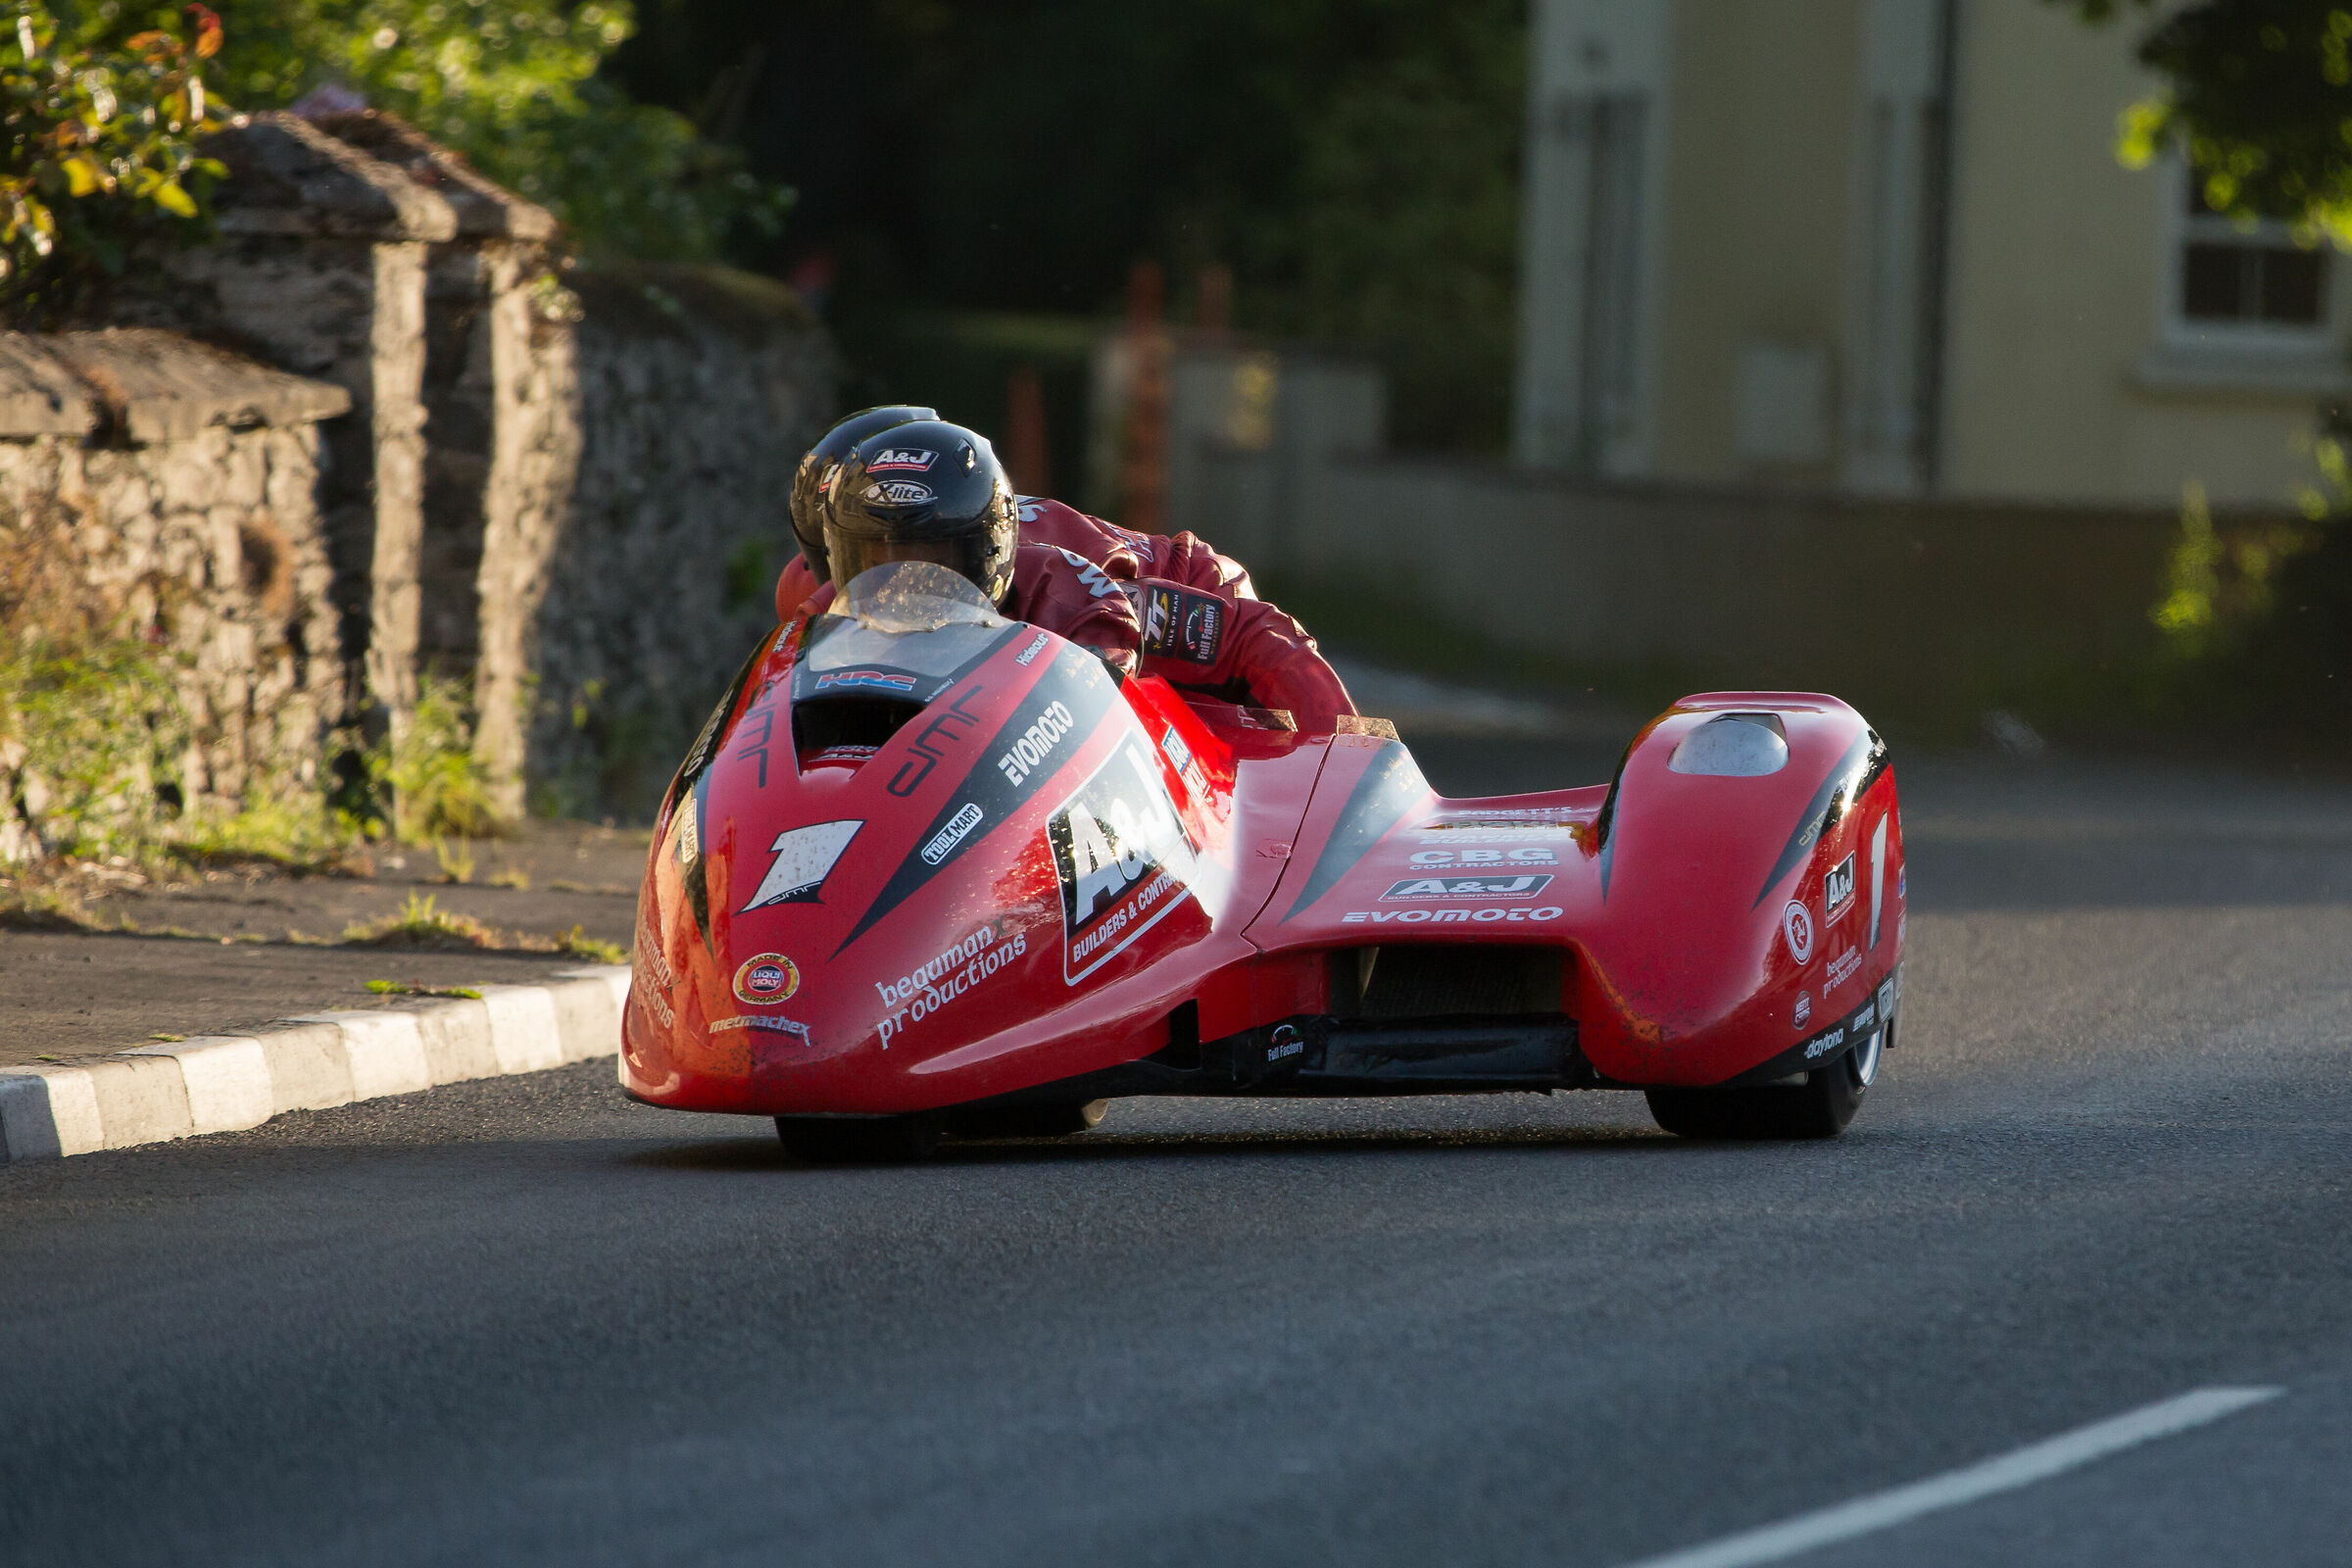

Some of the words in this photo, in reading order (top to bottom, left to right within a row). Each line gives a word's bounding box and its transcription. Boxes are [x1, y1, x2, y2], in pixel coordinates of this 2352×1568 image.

[873, 449, 931, 465] A&J
[1015, 632, 1050, 667] Hideout
[814, 670, 917, 692] HRC
[924, 832, 956, 860] TOOL
[950, 806, 979, 835] MART
[739, 819, 866, 912] 1
[1409, 848, 1553, 863] CBG
[1409, 860, 1560, 870] CONTRACTORS
[1396, 876, 1536, 894] A&J
[1828, 857, 1854, 910] A&J
[1869, 811, 1887, 951] 1
[1073, 908, 1127, 963] BUILDERS
[1128, 902, 1137, 920] &
[754, 969, 781, 978] LIQUI
[875, 926, 993, 1008] beauman
[877, 933, 1026, 1051] productions
